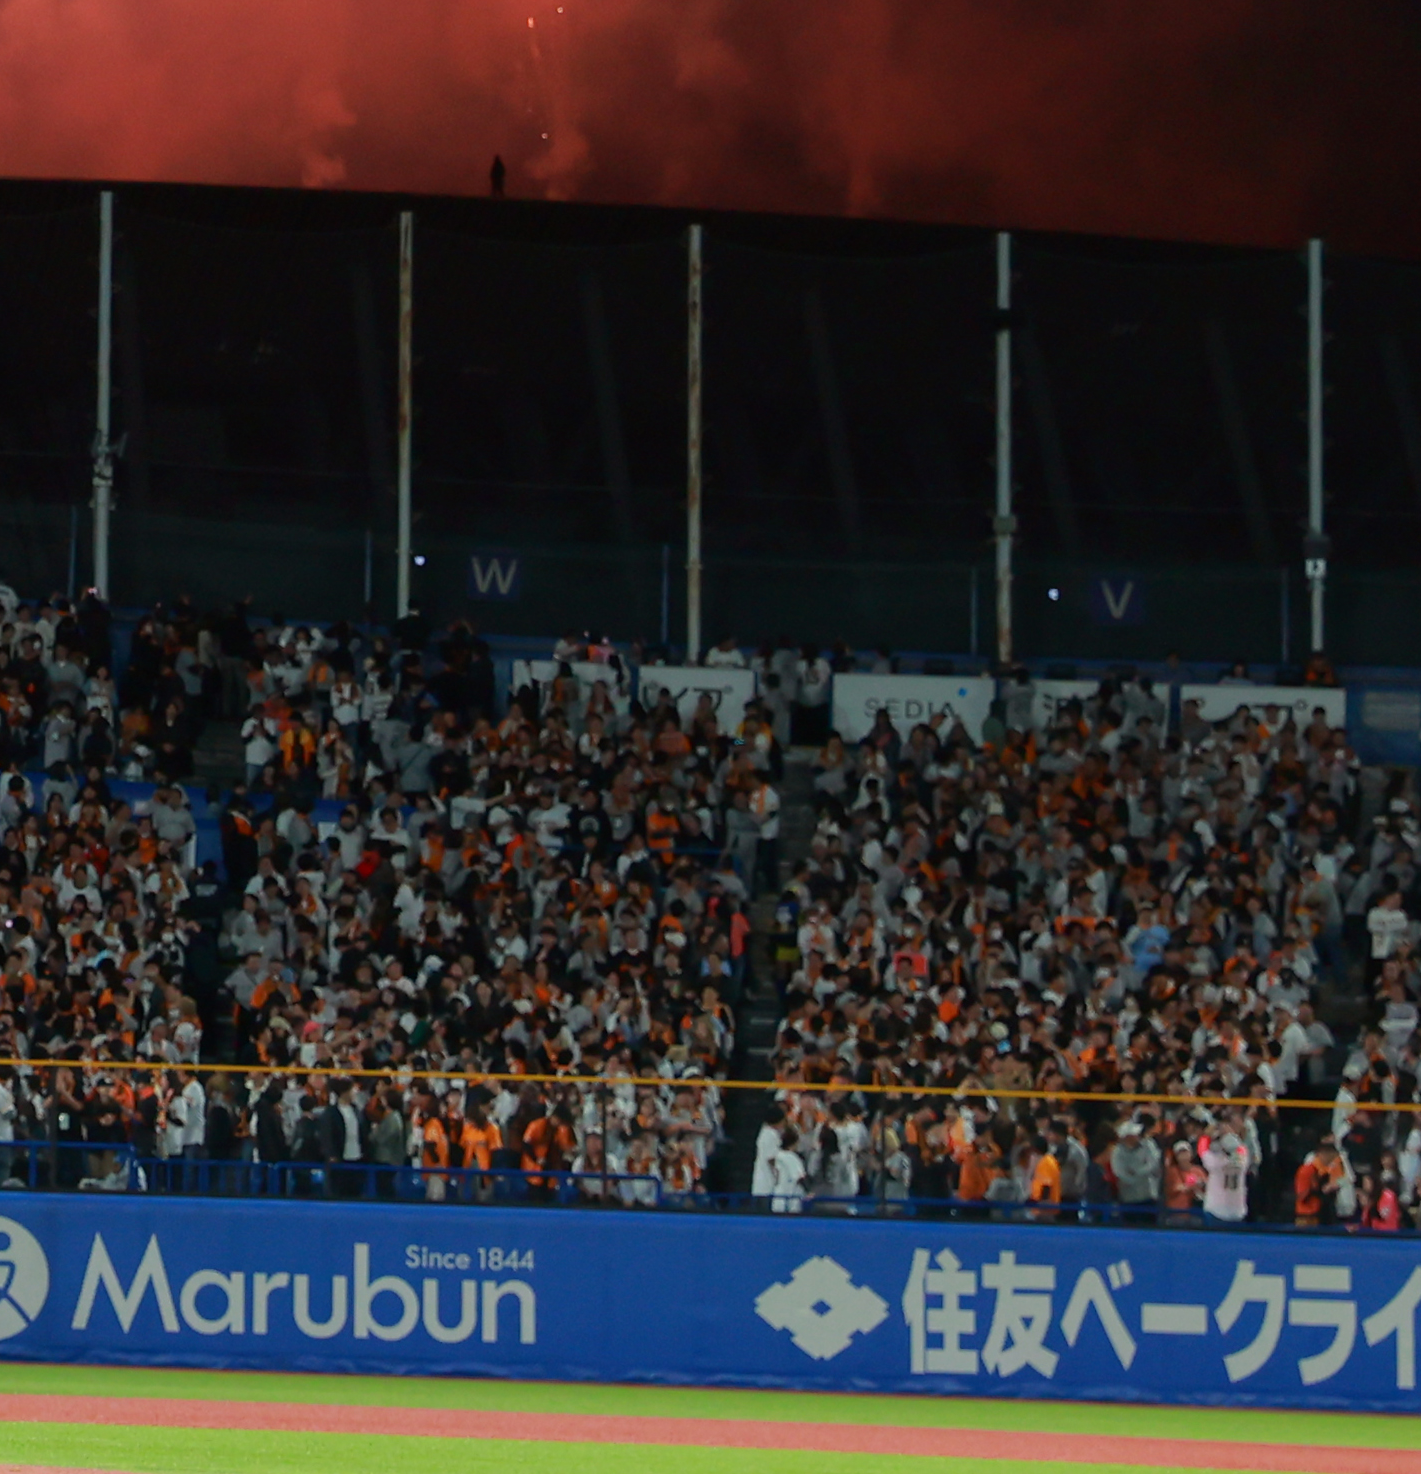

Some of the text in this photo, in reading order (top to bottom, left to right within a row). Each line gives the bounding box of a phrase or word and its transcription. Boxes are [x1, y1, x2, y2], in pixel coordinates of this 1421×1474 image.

[472, 556, 518, 595] W
[1101, 580, 1134, 619] V
[405, 1244, 535, 1272] Since 1844
[71, 1231, 537, 1345] Marubun
